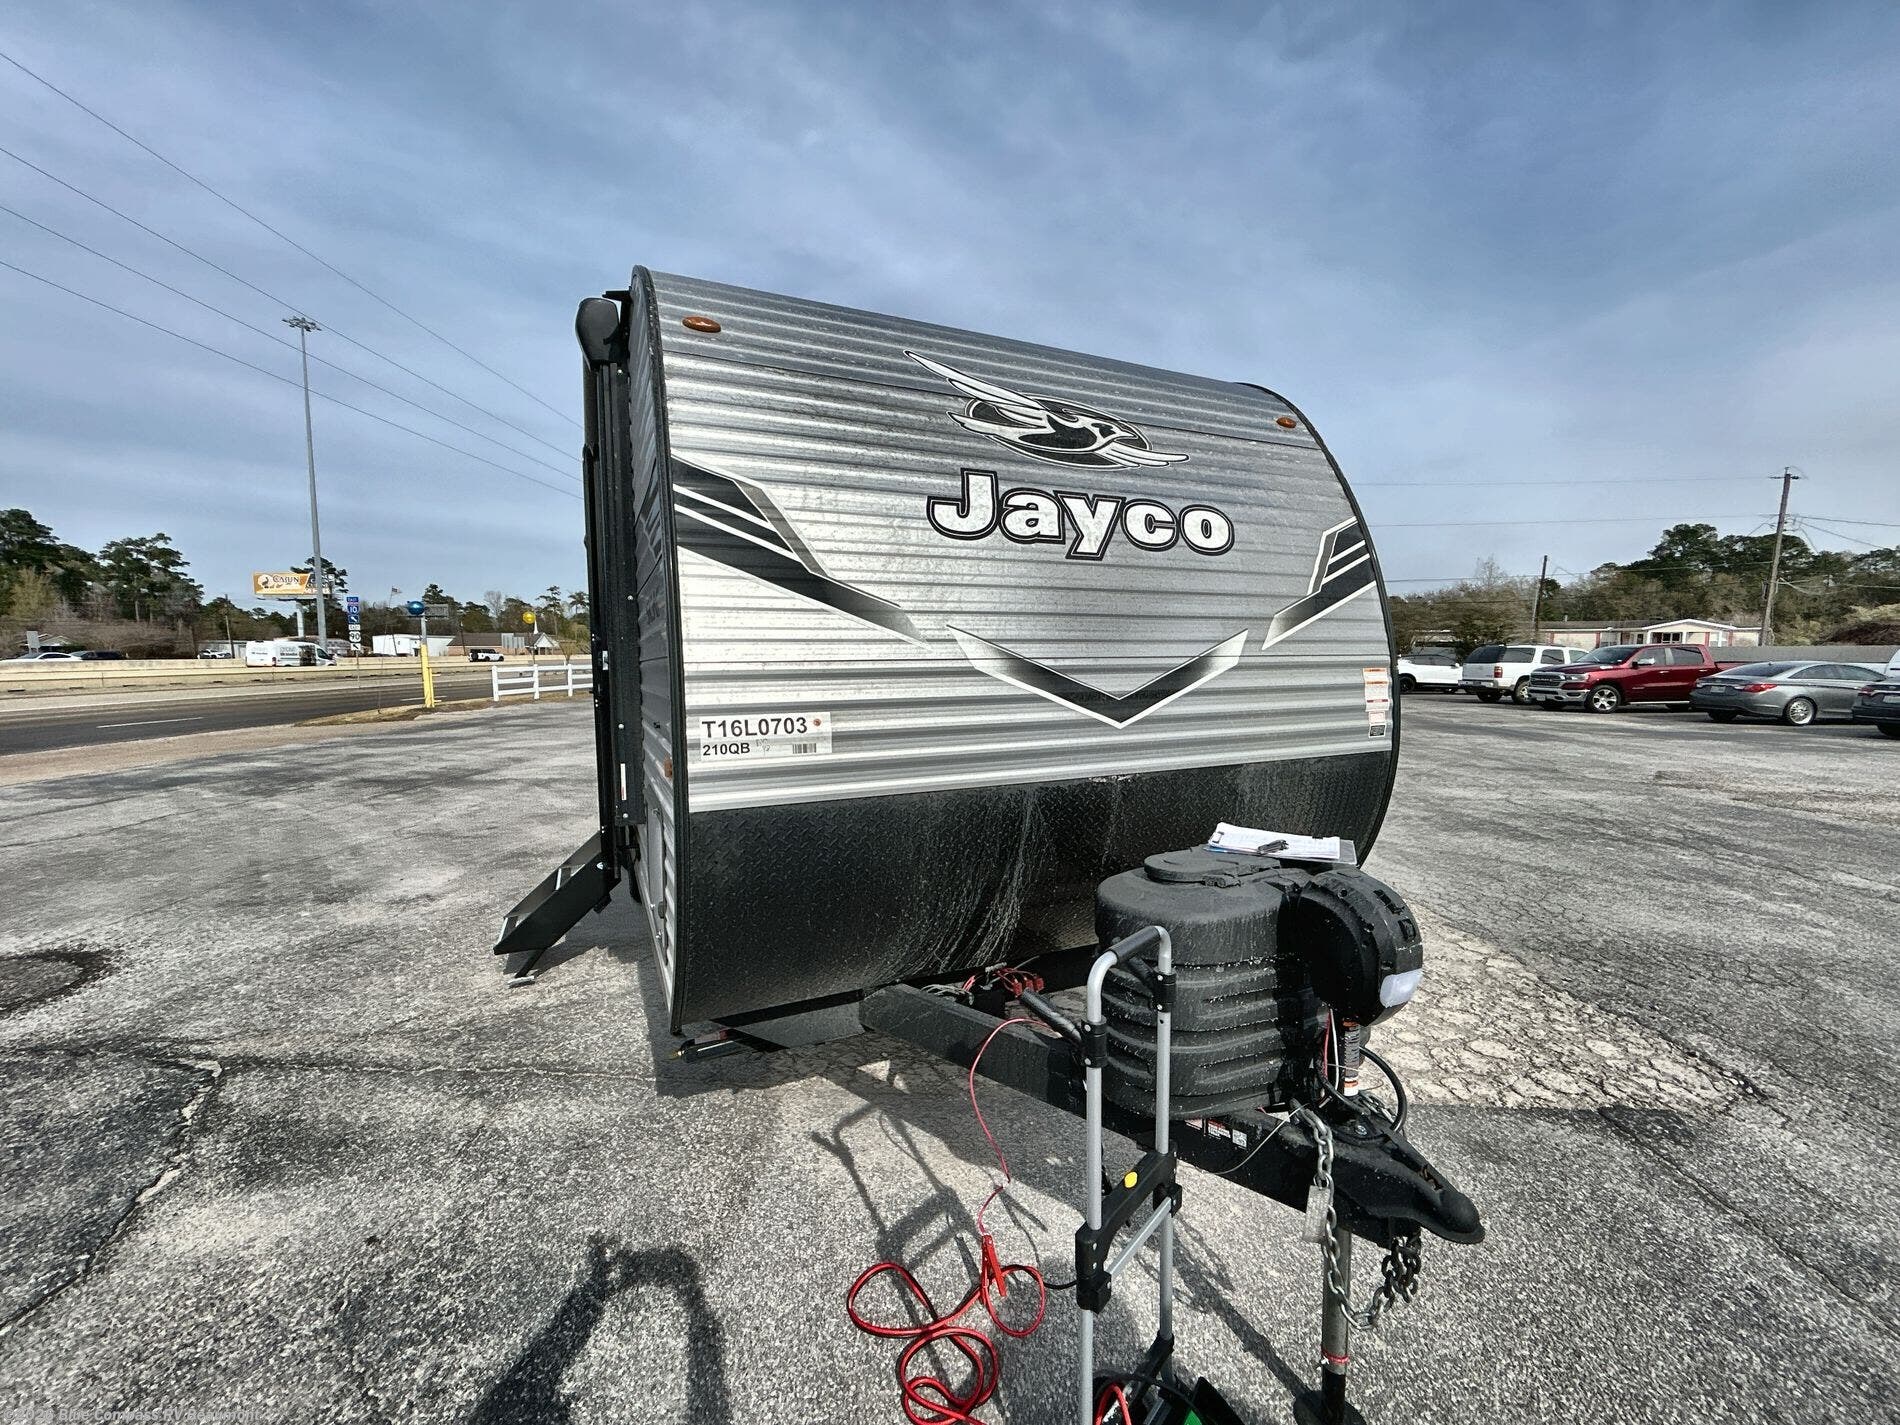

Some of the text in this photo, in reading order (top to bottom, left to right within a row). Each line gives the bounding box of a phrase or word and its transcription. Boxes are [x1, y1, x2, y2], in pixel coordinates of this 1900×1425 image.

[926, 467, 1235, 560] Jayco
[350, 605, 357, 613] 10
[350, 632, 360, 640] 90
[702, 717, 808, 738] T16L0703
[702, 742, 751, 756] 210QB
